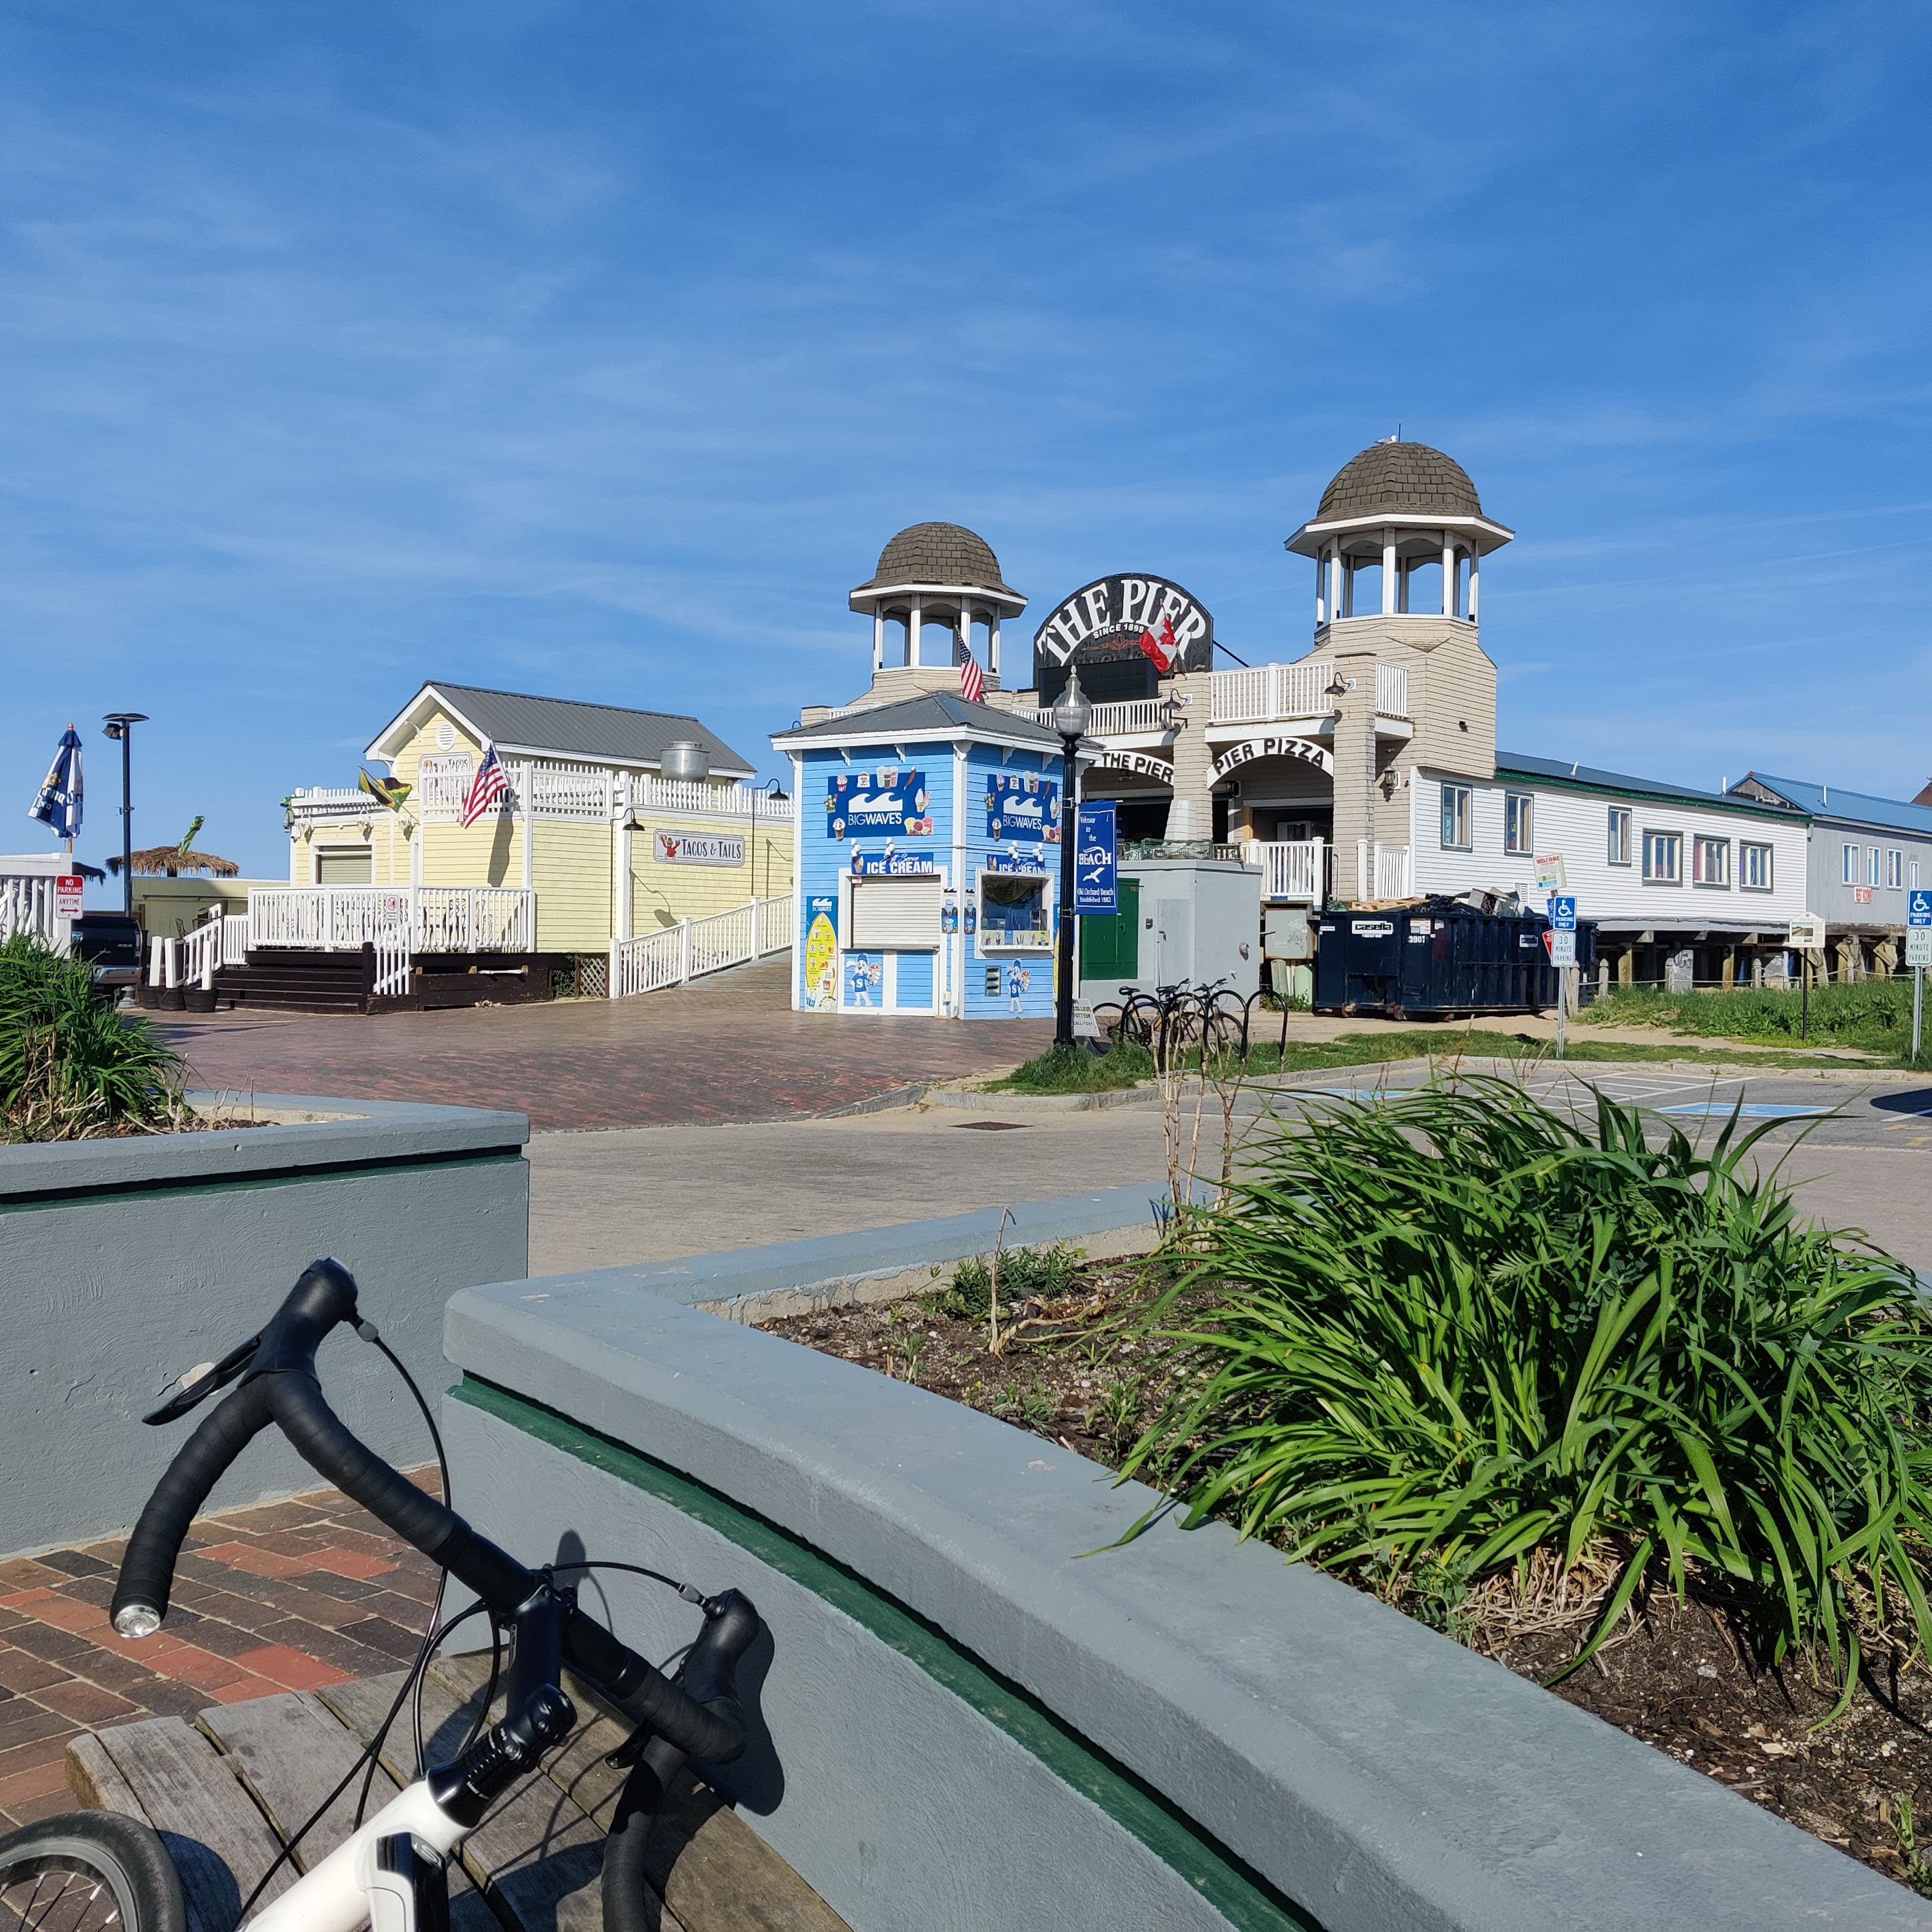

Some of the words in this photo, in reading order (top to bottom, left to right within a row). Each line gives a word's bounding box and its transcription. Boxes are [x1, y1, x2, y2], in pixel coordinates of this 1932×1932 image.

[1037, 582, 1111, 667] THE
[1119, 579, 1206, 660] PIER
[1093, 623, 1121, 639] SINCE
[1124, 623, 1145, 635] 1898
[1215, 743, 1255, 775] PIER
[1263, 737, 1325, 767] PIZZA
[1102, 752, 1131, 769] THE
[1134, 756, 1174, 783] PIER
[1089, 833, 1097, 842] the
[710, 842, 717, 856] &
[1078, 847, 1113, 865] BEACH
[866, 861, 887, 875] ICE
[889, 861, 933, 874] CREAM
[999, 863, 1013, 873] ICE
[65, 879, 74, 887] NO
[57, 886, 83, 894] PARKING
[59, 897, 81, 905] ANYTIME
[1355, 922, 1392, 931] casella
[1559, 936, 1568, 945] 30
[1914, 931, 1925, 941] 30
[1909, 943, 1929, 951] MINUTE
[1554, 954, 1572, 962] PARKING
[855, 978, 863, 989] S
